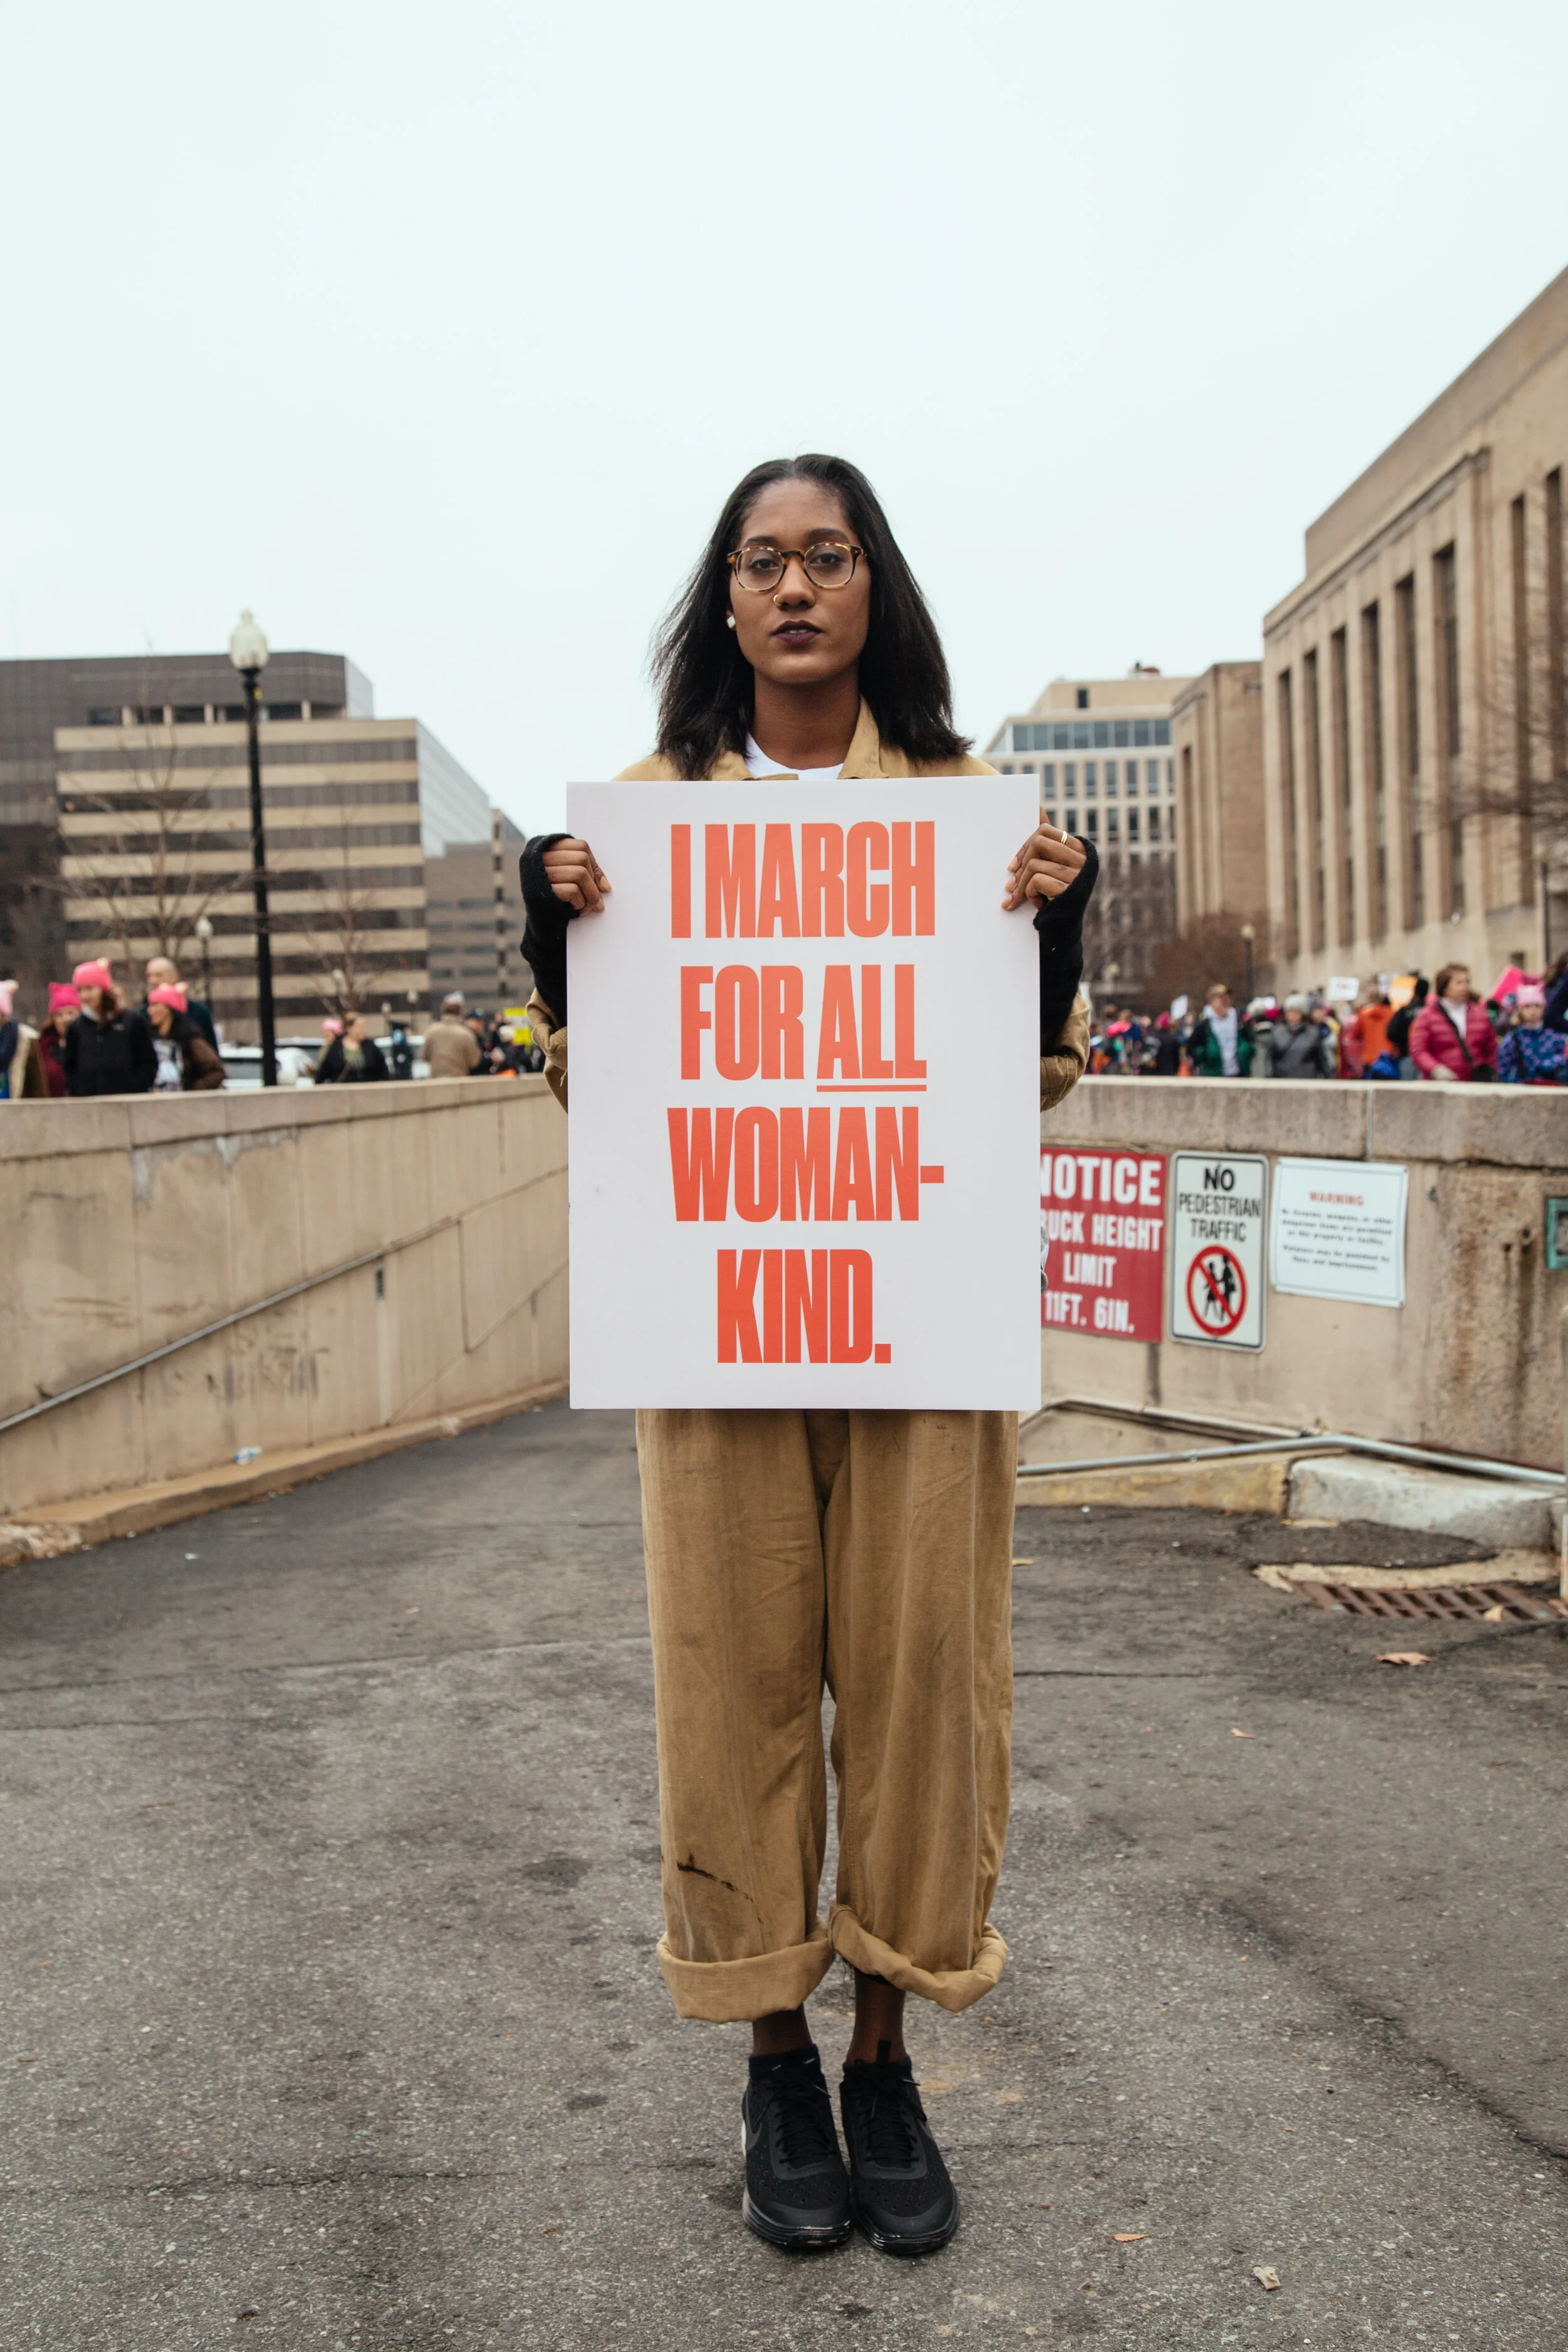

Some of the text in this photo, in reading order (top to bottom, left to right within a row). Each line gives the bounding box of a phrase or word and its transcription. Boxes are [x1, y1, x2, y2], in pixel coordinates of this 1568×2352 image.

[670, 821, 935, 939] I MARCH
[681, 964, 927, 1081] FOR ALL
[667, 1106, 945, 1223] WOMAN-
[1204, 1167, 1234, 1191] NO
[1179, 1193, 1261, 1217] PEDESTRIAN
[1041, 1208, 1163, 1252] UCK HEIGHT
[1191, 1218, 1246, 1242] TRAFFIC
[1063, 1251, 1117, 1288] LIMIT
[717, 1249, 891, 1364] KIND.
[1094, 1296, 1135, 1333] 6IN.
